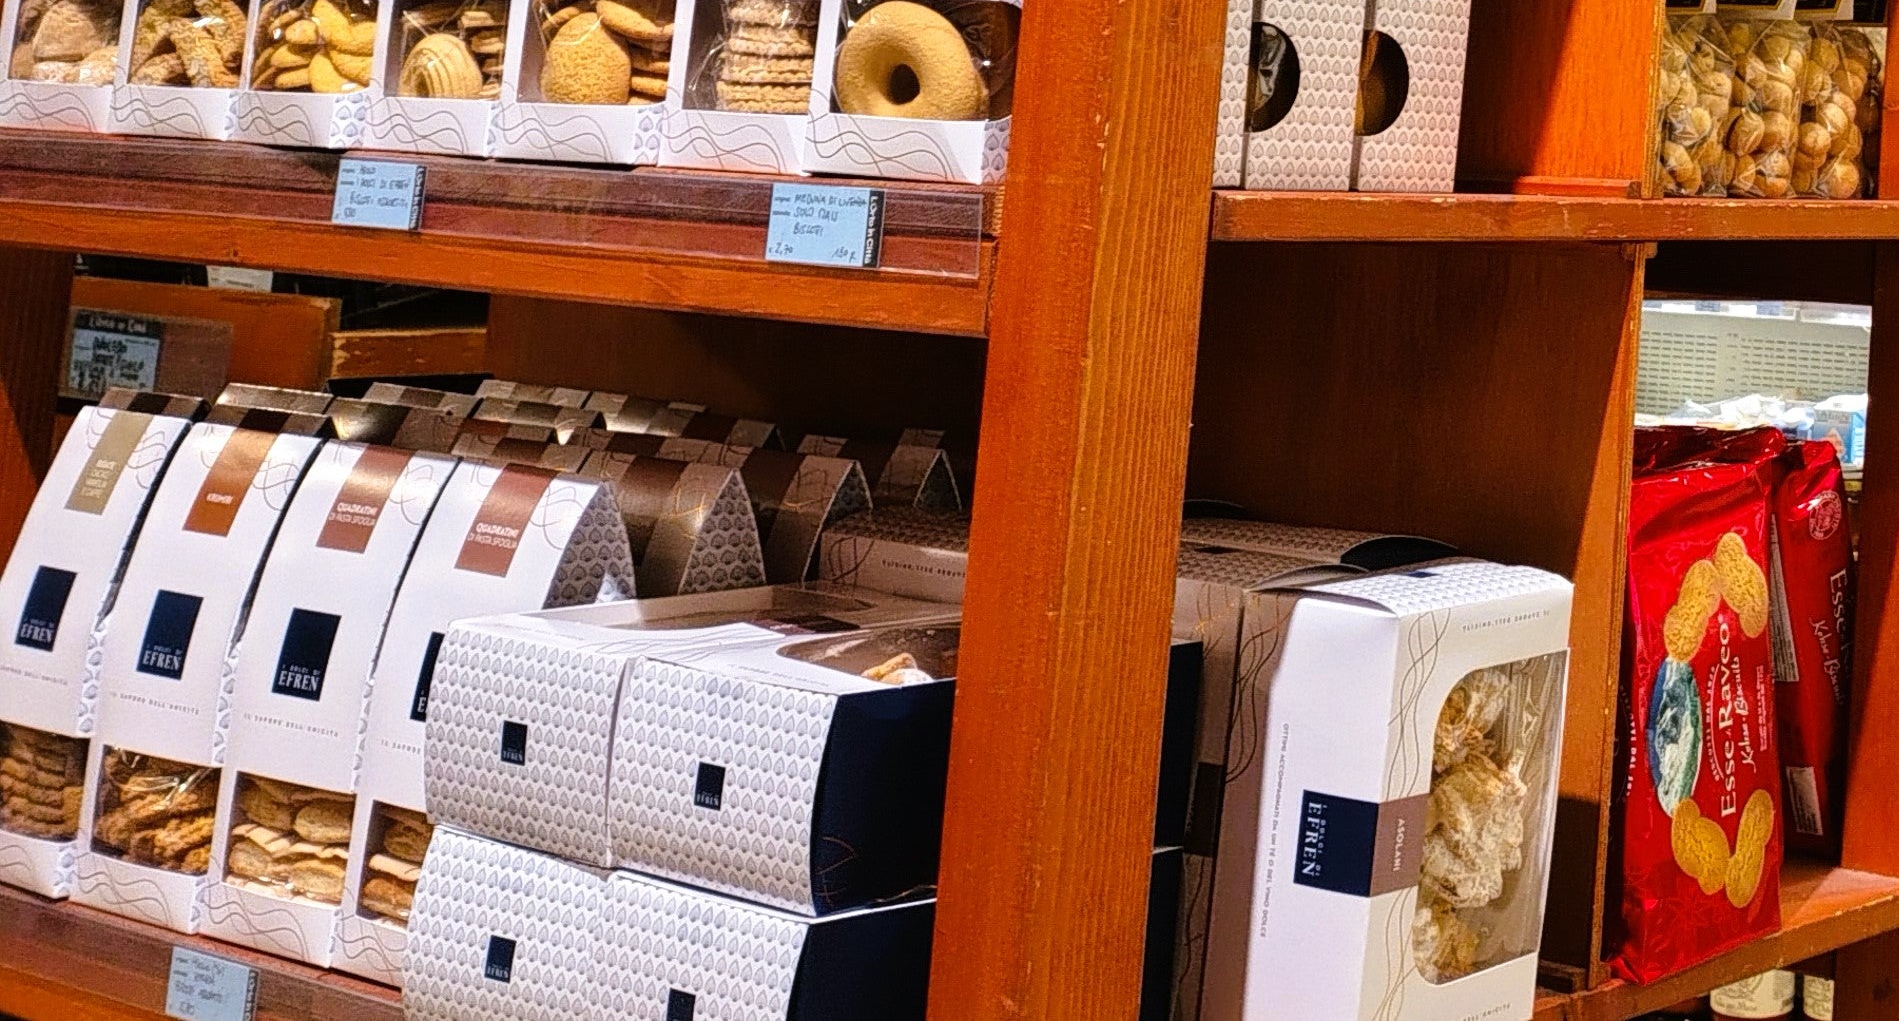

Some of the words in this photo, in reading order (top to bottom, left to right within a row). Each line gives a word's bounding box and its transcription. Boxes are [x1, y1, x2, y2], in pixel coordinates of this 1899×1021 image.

[336, 501, 378, 516] QUADRATINI
[476, 522, 519, 537] QUADRATINI
[20, 624, 53, 643] EFREN
[143, 650, 181, 671] EFREN
[278, 672, 319, 692] EFREN
[1719, 622, 1734, 729] Raveo
[1720, 740, 1737, 817] Esse
[1302, 801, 1323, 877] EFREN
[1392, 818, 1406, 872] ASOLANI
